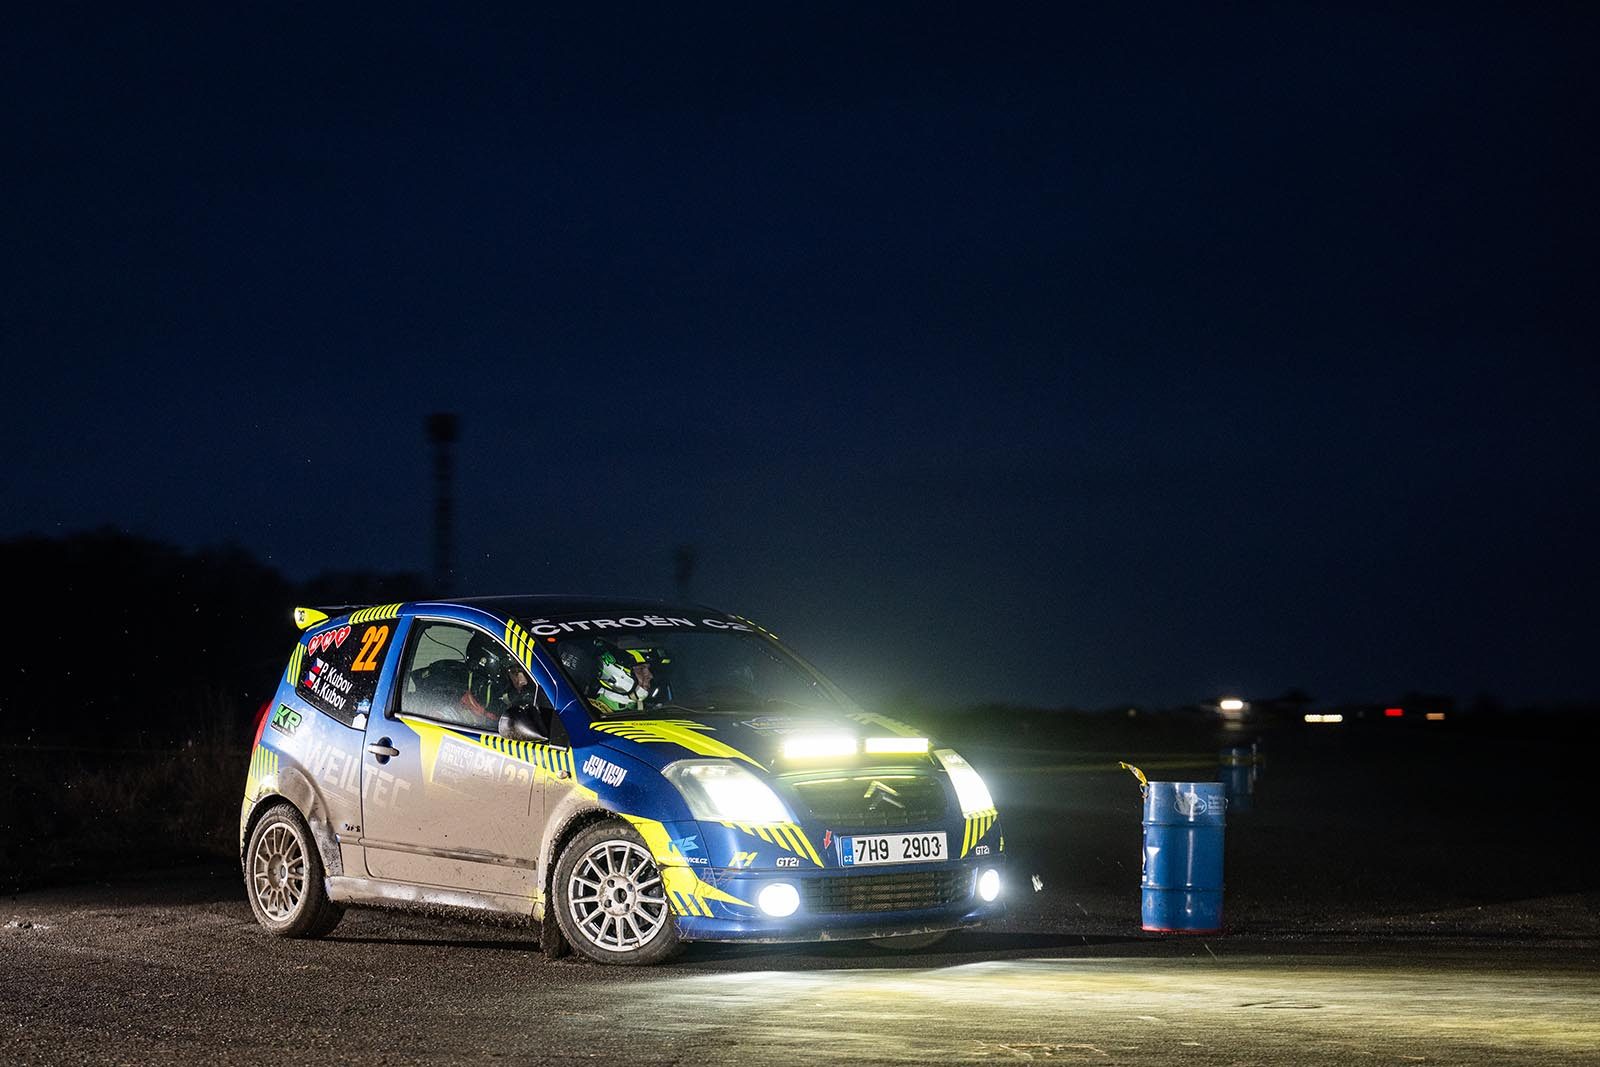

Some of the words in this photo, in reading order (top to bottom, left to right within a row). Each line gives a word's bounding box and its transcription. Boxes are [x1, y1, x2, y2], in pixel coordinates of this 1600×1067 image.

[531, 615, 697, 635] CITROËN
[702, 618, 753, 632] C2
[351, 625, 389, 672] 22
[319, 662, 353, 694] P.Kubov
[311, 678, 346, 710] A.Kubov
[272, 704, 301, 734] KR
[857, 839, 889, 862] 7H9
[902, 836, 940, 859] 2903
